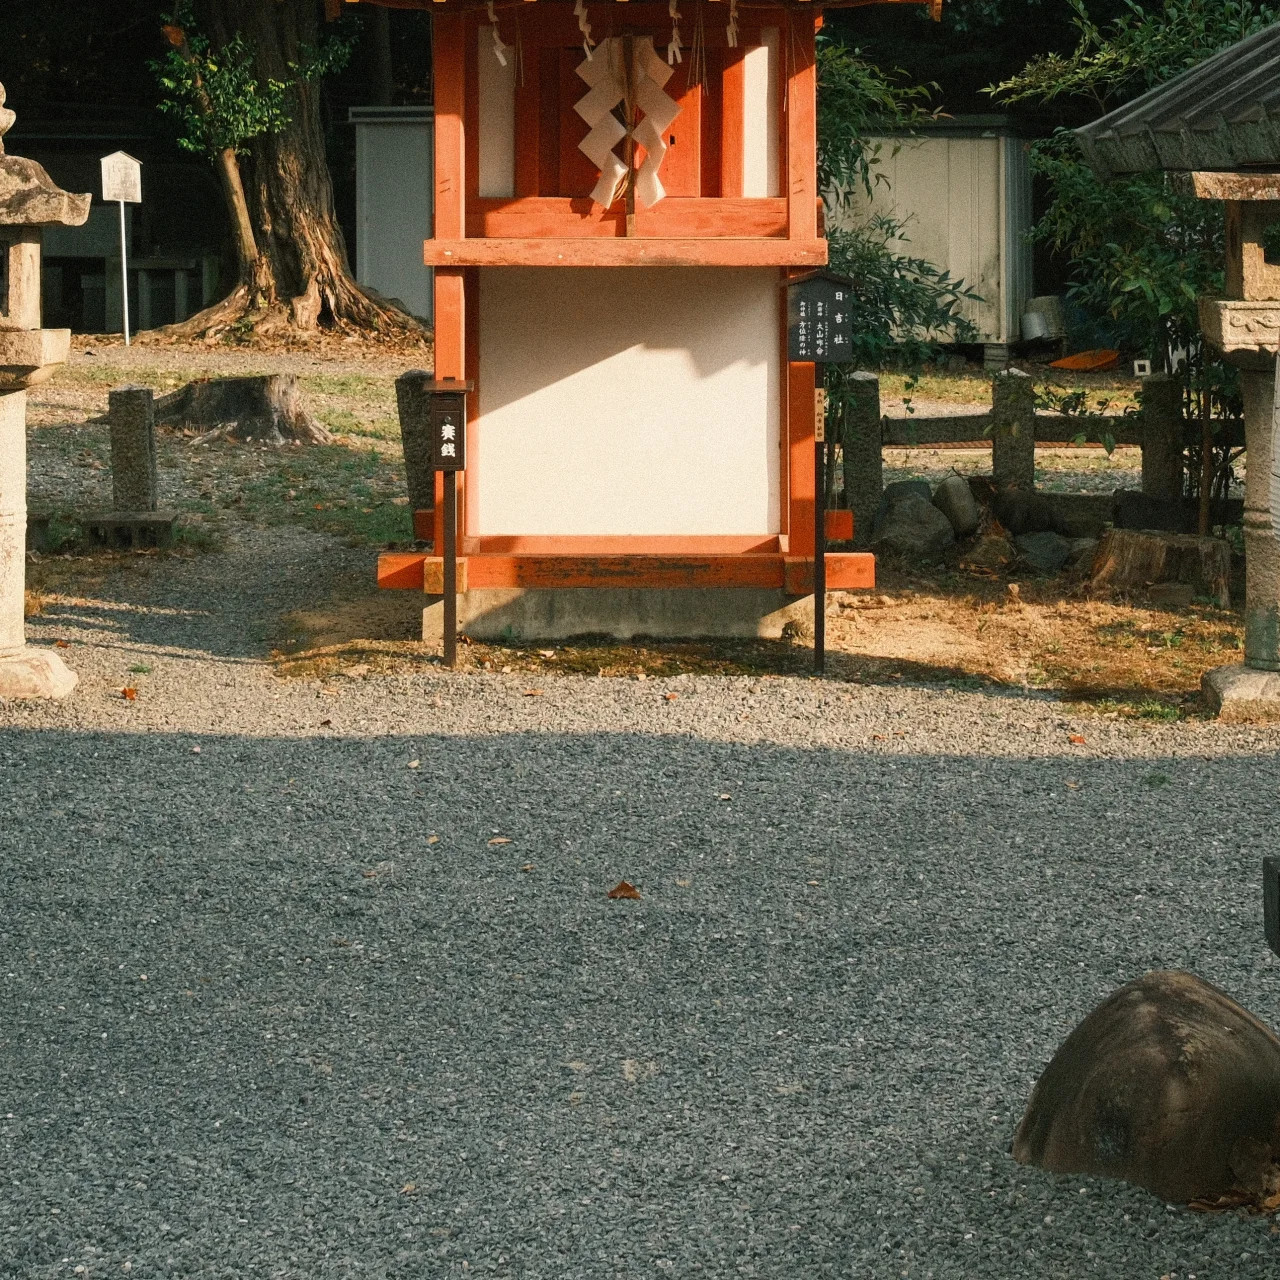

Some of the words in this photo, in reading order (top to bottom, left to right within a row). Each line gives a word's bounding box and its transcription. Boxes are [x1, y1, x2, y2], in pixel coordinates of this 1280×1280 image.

[833, 291, 845, 344] 日吉社
[441, 424, 456, 457] 賽銭
